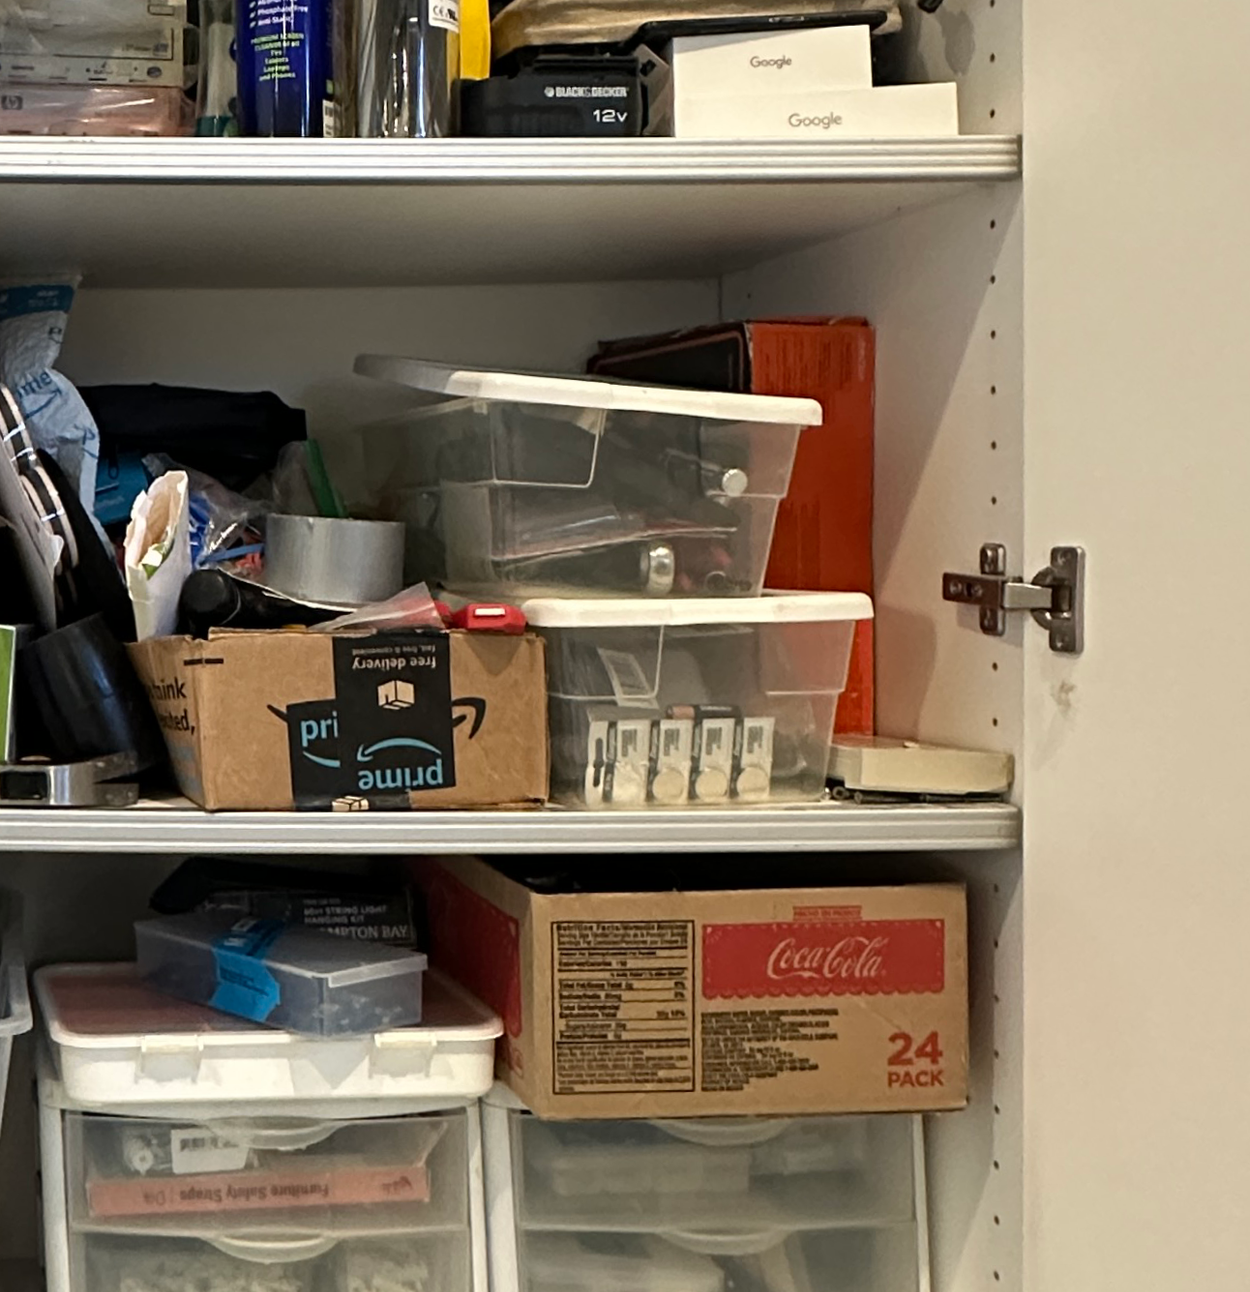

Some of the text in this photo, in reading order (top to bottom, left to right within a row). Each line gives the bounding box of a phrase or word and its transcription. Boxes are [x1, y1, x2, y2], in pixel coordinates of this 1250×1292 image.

[750, 55, 793, 70] Google
[788, 112, 843, 130] Google
[352, 656, 437, 671] free delivery
[301, 710, 339, 748] pri
[357, 757, 445, 792] prime
[766, 936, 890, 981] Coca-Cola
[887, 1030, 944, 1067] 24
[887, 1069, 945, 1088] PACK
